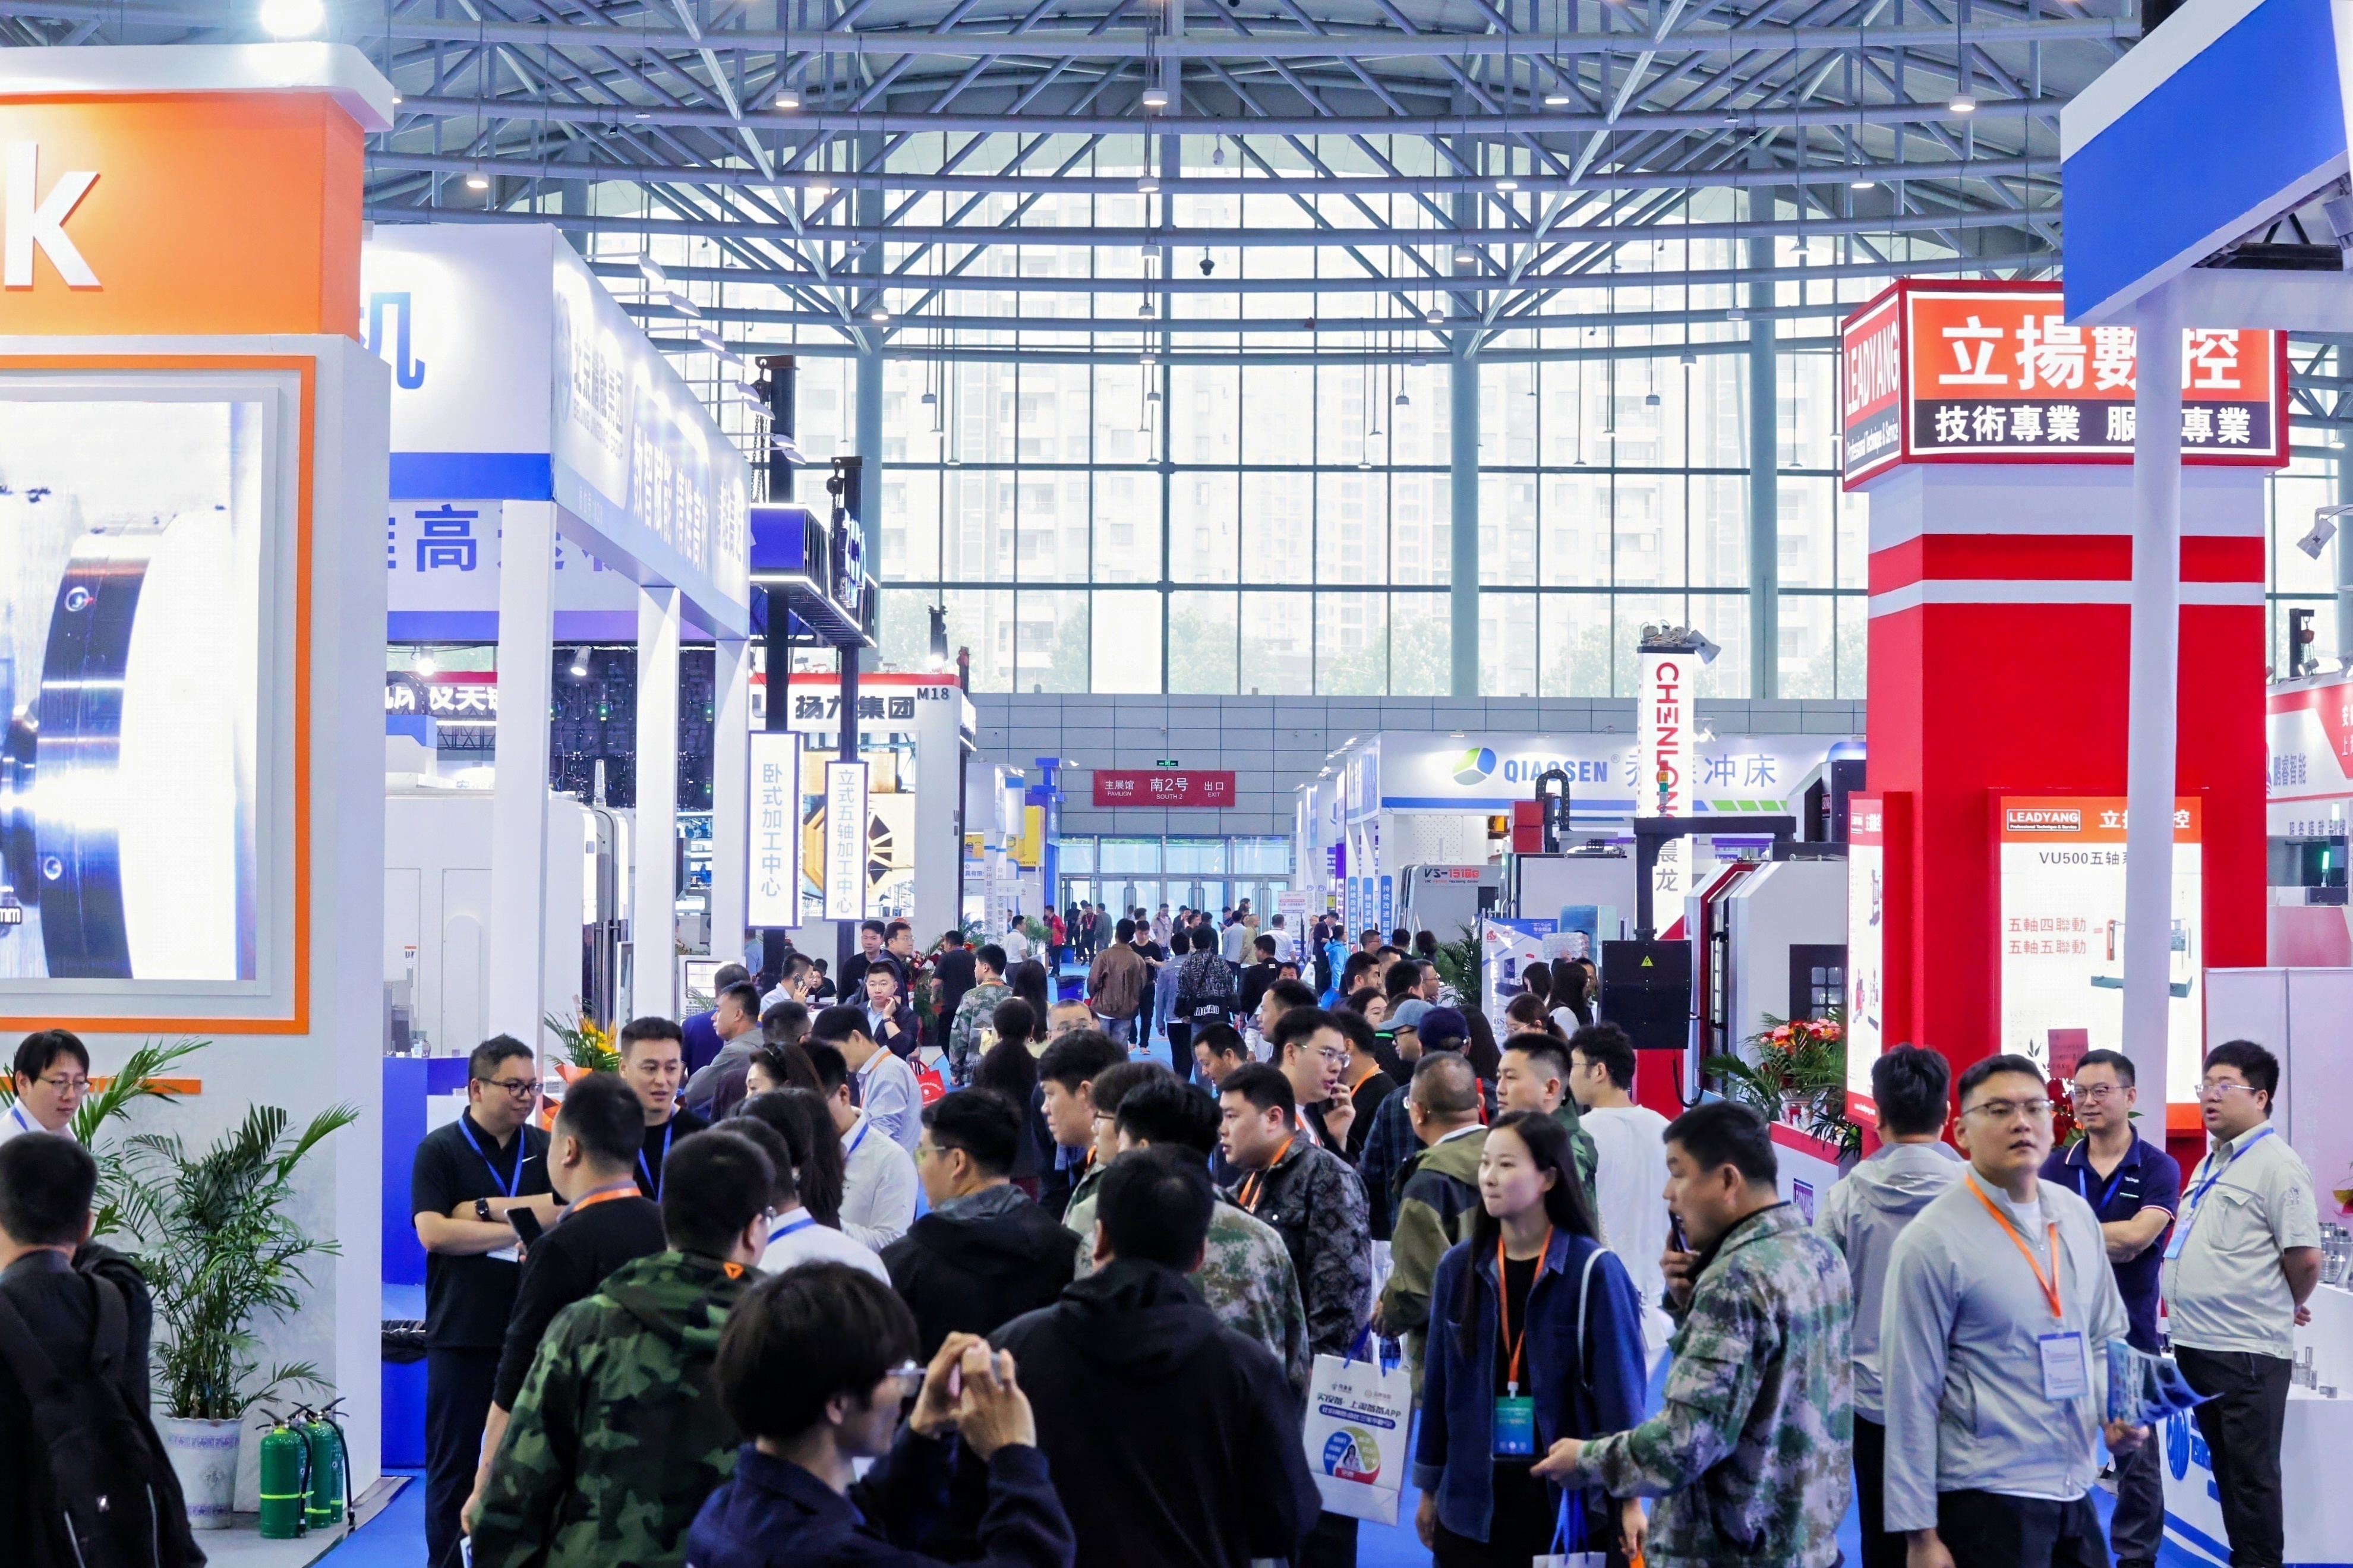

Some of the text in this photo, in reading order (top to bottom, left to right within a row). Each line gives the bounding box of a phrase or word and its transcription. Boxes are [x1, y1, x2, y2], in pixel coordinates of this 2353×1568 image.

[1846, 320, 1898, 417] LEADYANG
[1936, 405, 2251, 444] 技術專業 服專業
[917, 687, 950, 701] M18
[1105, 777, 1224, 792] 主展馆 南2号 出口
[2009, 812, 2079, 823] LEADYANG
[2099, 809, 2190, 829] 立控
[761, 763, 783, 897] 卧式加工中心
[836, 769, 854, 914] 立式五轴加工中心
[2039, 851, 2127, 866] VU500五轴
[2008, 917, 2087, 932] 五軸四聯動
[2008, 939, 2087, 954] 五軸五聯動
